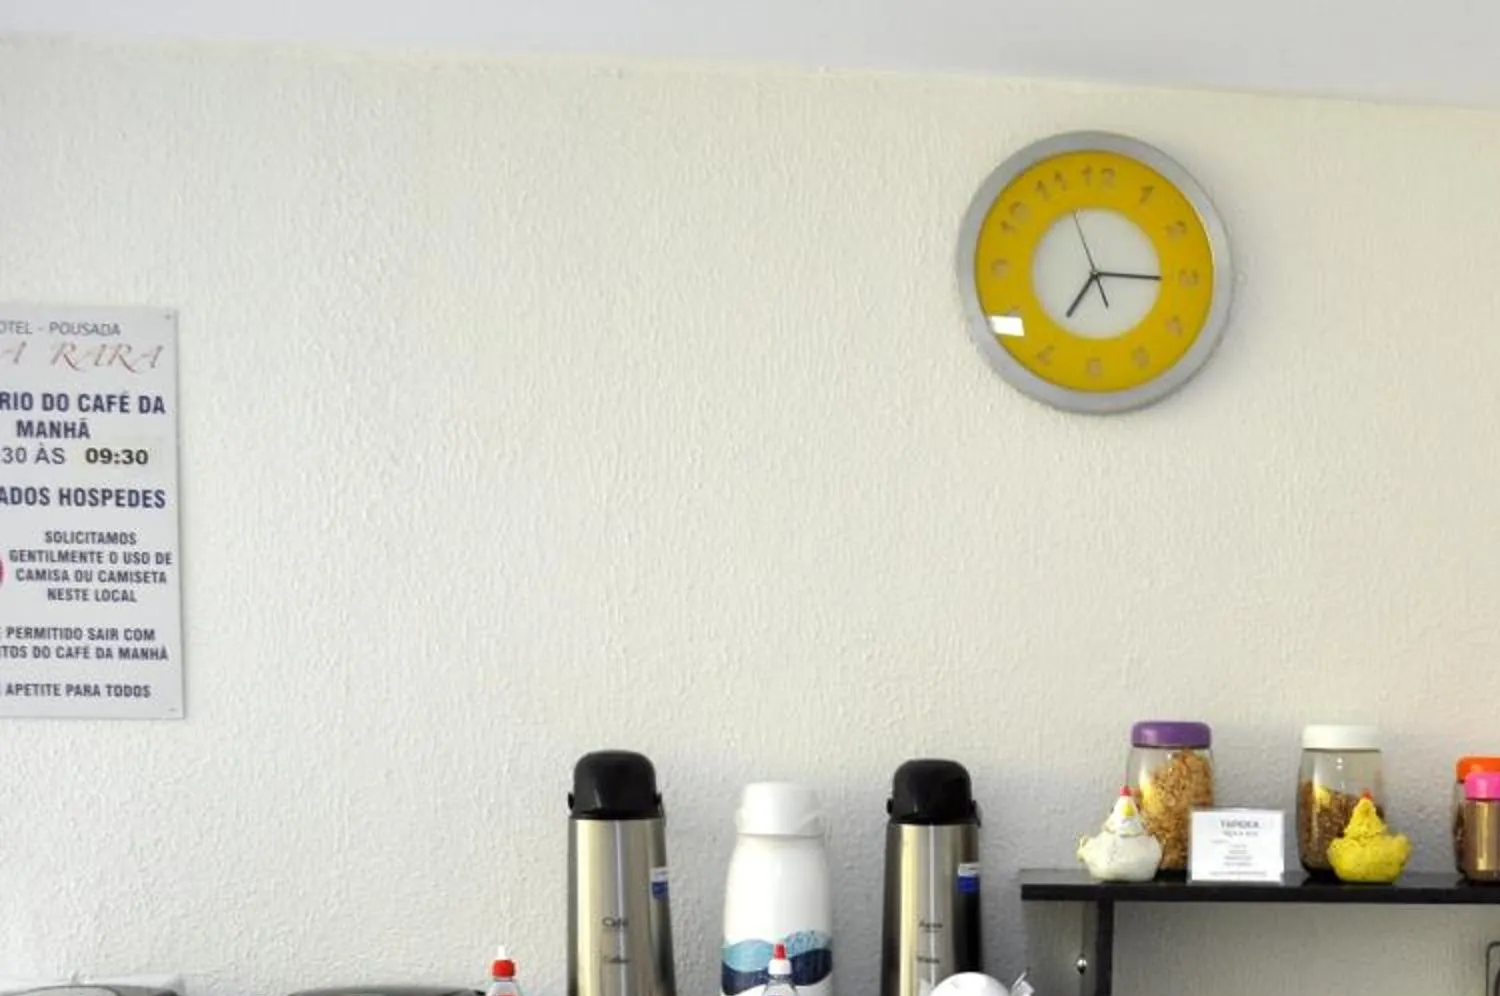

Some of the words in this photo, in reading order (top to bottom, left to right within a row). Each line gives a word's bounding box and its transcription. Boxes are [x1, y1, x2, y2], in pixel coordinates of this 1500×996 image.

[1080, 164, 1116, 187] 12
[49, 321, 121, 336] POUSADA
[0, 391, 34, 411] RIO
[41, 393, 70, 412] DO
[78, 390, 130, 414] CAFÉ
[138, 395, 166, 414] DA
[16, 417, 91, 439] MANHÃ
[2, 447, 27, 464] 30
[85, 447, 149, 465] 09:30
[0, 486, 51, 506] ADOS
[58, 488, 166, 508] HOSPEDES
[44, 531, 138, 545] SOLICITAMOS
[9, 550, 104, 564] GENTILMENTE
[109, 551, 119, 565] O
[123, 552, 150, 565] USO
[155, 552, 173, 565] DE
[15, 568, 70, 581] CAMISA
[75, 570, 93, 583] OU
[97, 571, 168, 584] CAMISETA
[47, 588, 90, 601] NESTE
[94, 589, 138, 602] LOCAL
[6, 626, 83, 640] PERMITIDO
[87, 627, 119, 641] SAIR
[123, 628, 156, 641] COM
[32, 645, 51, 659] DO
[95, 647, 113, 660] DA
[5, 683, 61, 697] APETITE
[65, 684, 101, 697] PARA
[105, 684, 152, 698] TODOS
